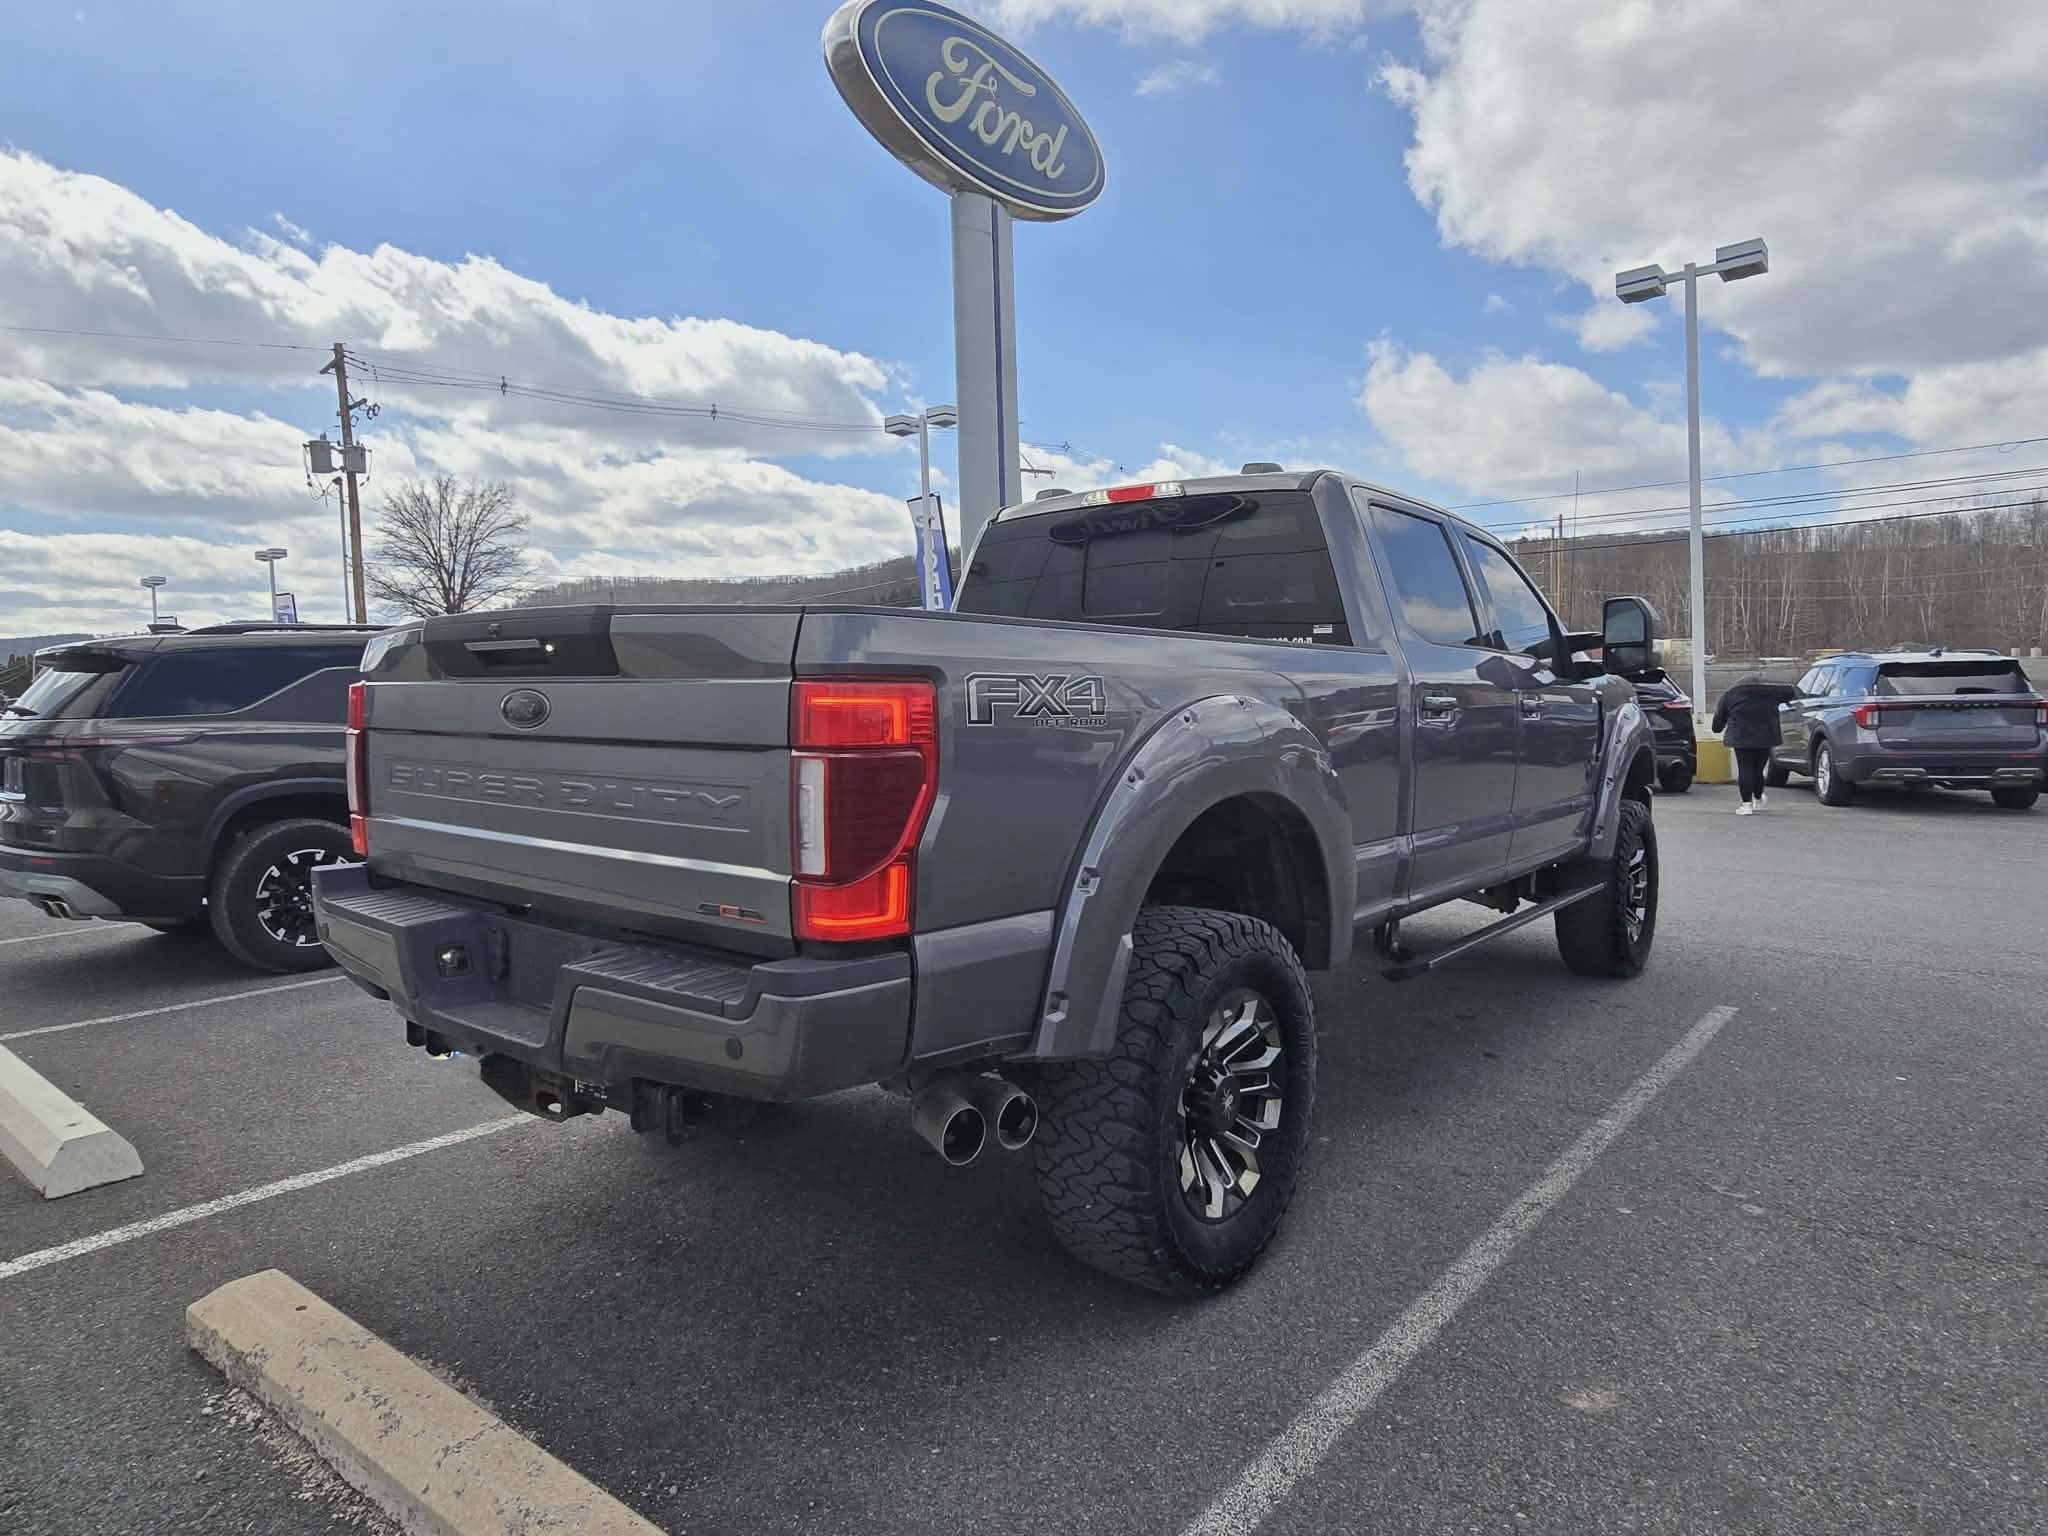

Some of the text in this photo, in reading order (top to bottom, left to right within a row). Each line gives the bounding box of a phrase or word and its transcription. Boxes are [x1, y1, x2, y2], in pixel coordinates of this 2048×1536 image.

[925, 35, 1068, 179] Ford
[964, 671, 1108, 727] FX4
[1034, 718, 1106, 728] OFF ROAD
[390, 764, 743, 822] SUPER DUTY
